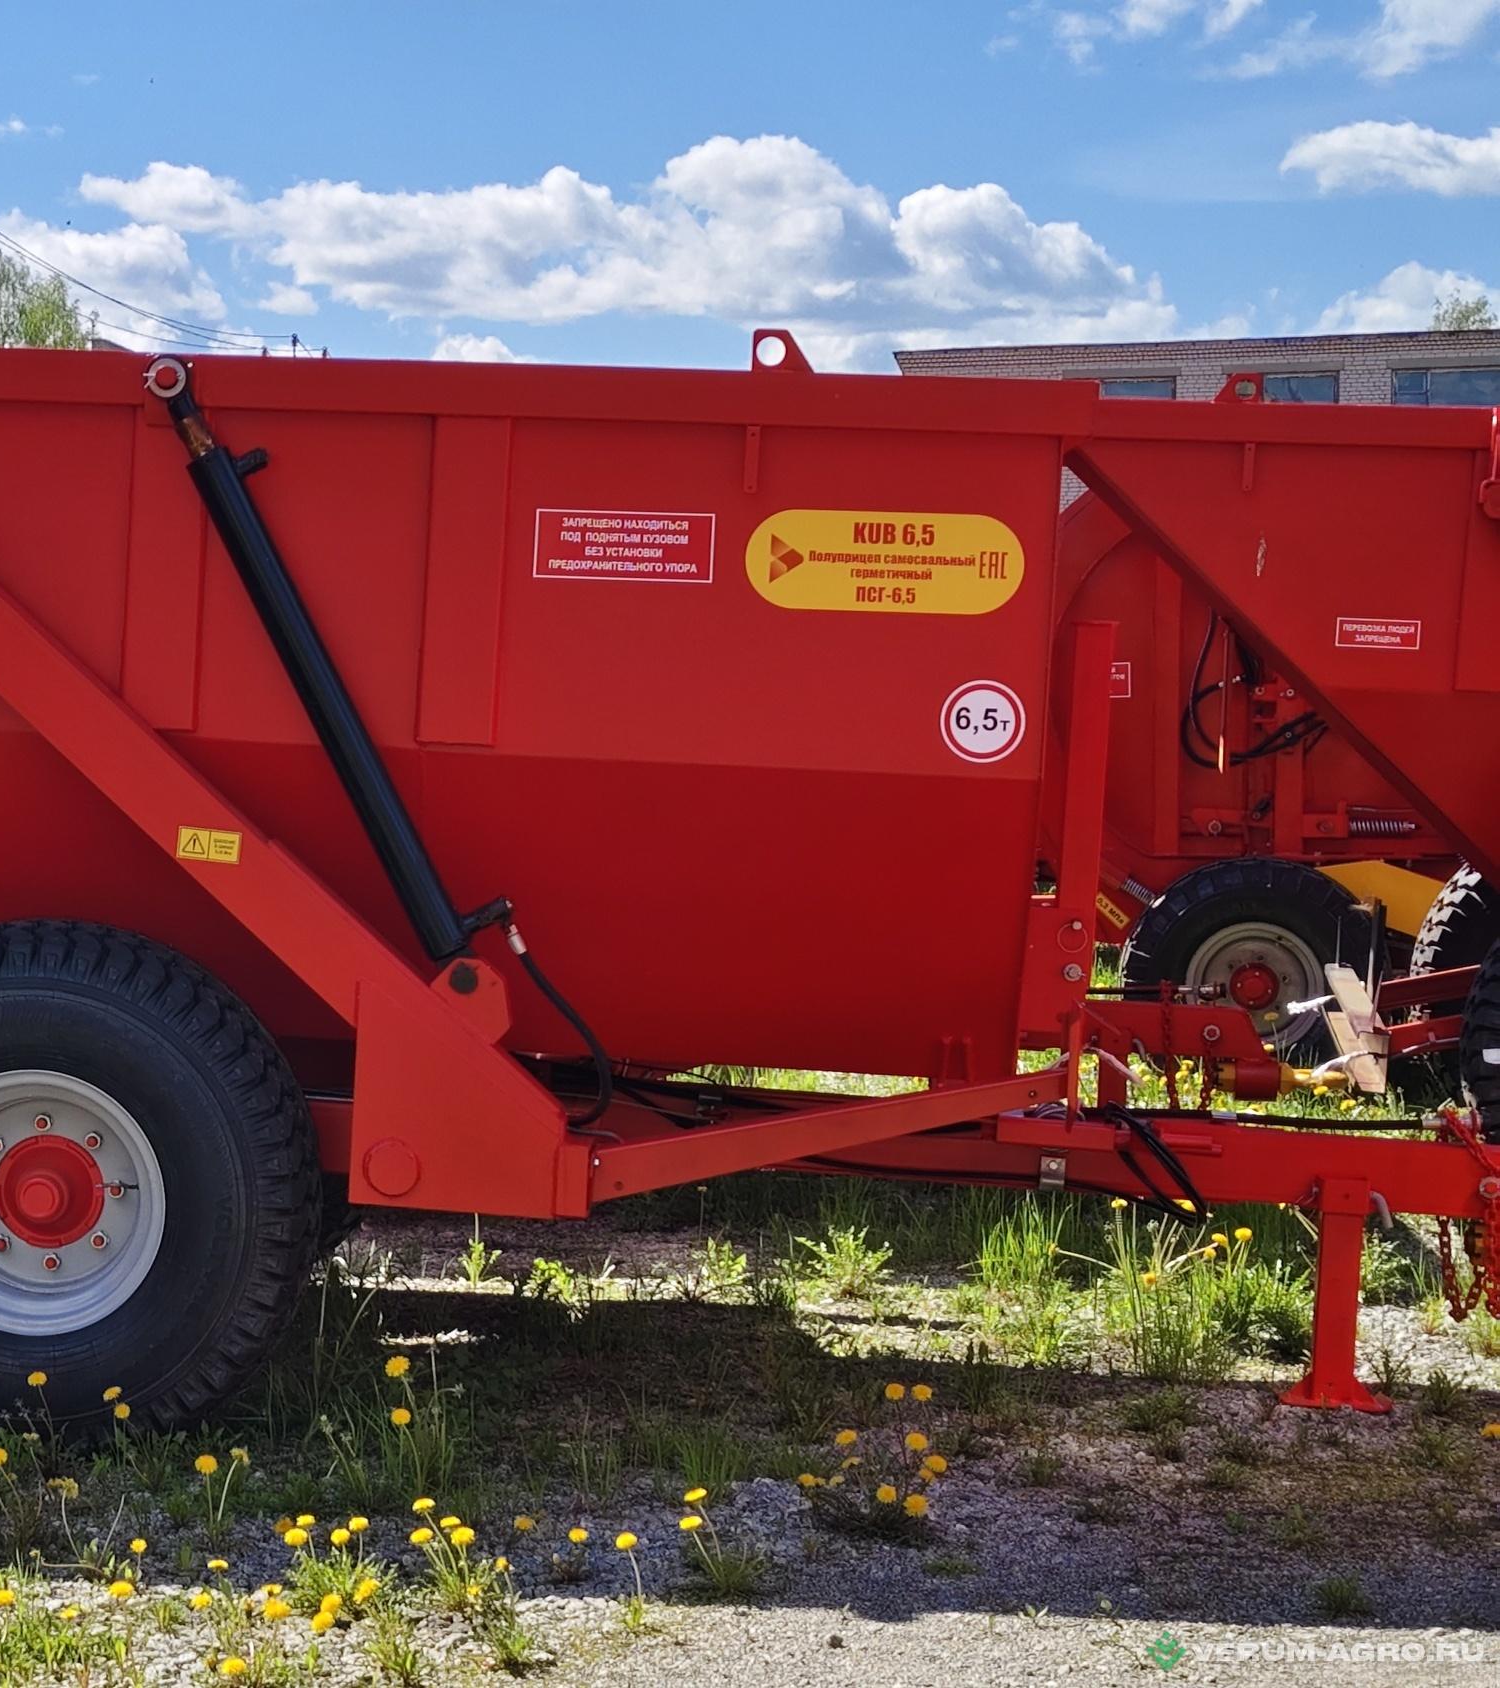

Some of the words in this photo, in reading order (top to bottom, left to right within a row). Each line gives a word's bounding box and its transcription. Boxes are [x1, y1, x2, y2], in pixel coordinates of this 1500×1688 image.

[562, 517, 622, 529] ЗАПРЕЩЕНО
[623, 519, 689, 531] НАХОДИТЬСЯ
[560, 531, 581, 543] ПОД
[585, 532, 641, 544] ПОДНЯТЫМ
[642, 534, 689, 545] КУЗОВОМ
[853, 522, 896, 544] KUB
[902, 523, 935, 547] 6,5
[584, 546, 604, 556] БЕЗ
[606, 547, 663, 558] УСТАНОВКИ
[808, 550, 882, 565] Полуприцеп
[883, 552, 976, 567] самосвальный
[548, 559, 665, 573] ПРЕДОХРАНИТЕЛЬНОГО
[665, 563, 698, 573] УПОРА
[850, 567, 933, 581] герметичный
[855, 586, 916, 605] ПСГ-6,5
